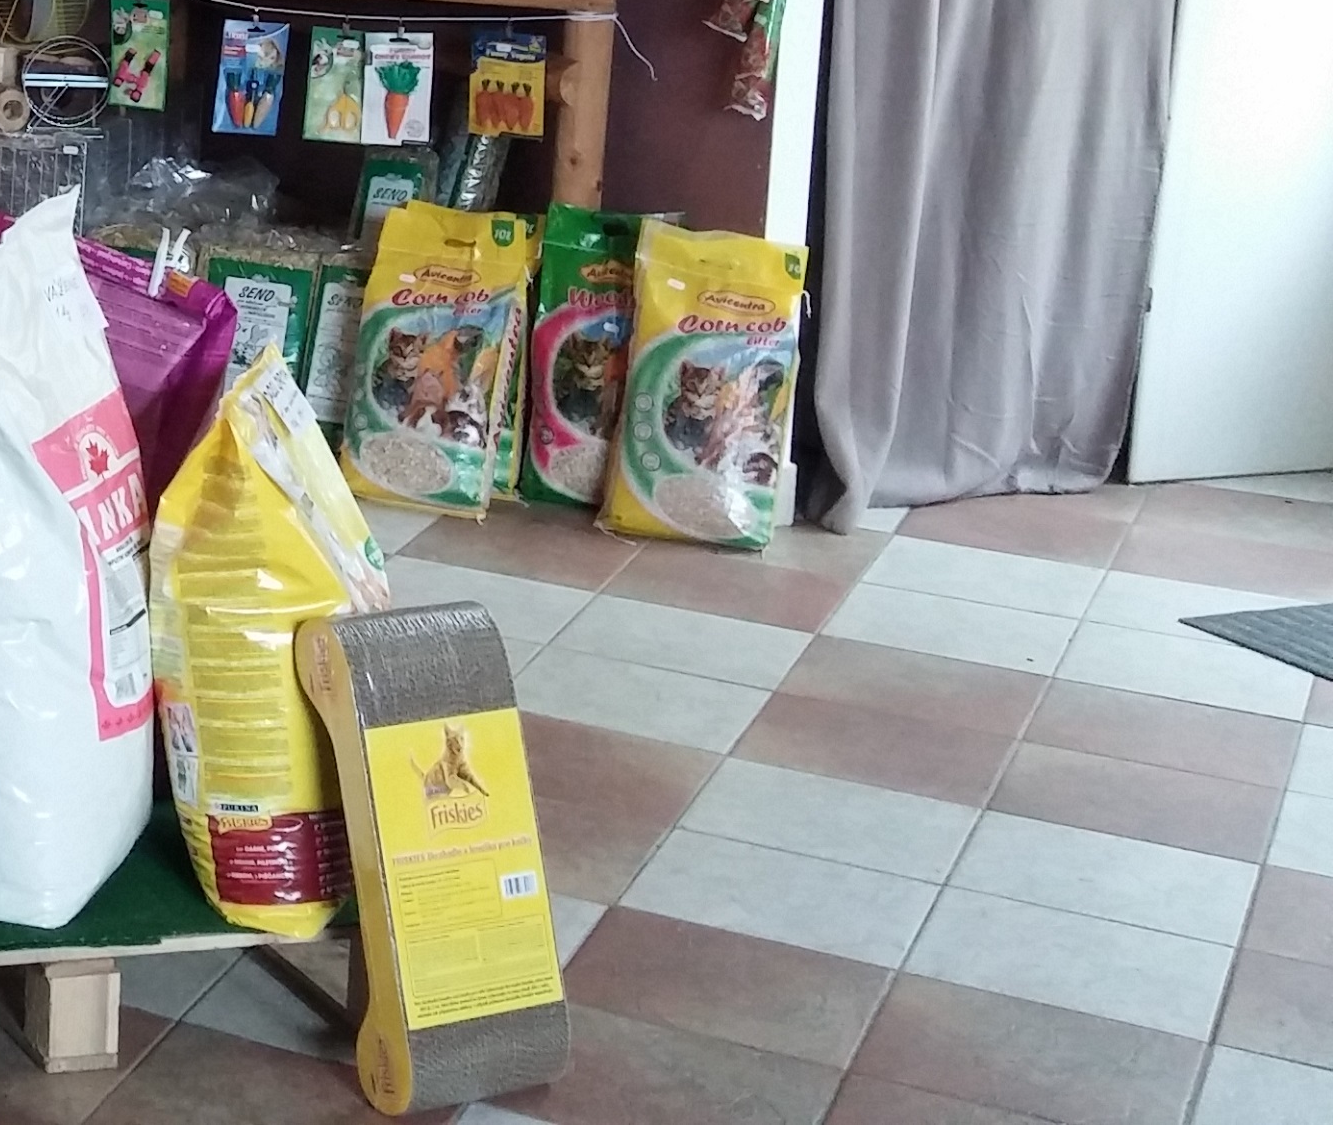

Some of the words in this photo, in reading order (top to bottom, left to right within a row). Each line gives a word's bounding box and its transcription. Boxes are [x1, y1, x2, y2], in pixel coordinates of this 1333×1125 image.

[371, 186, 408, 202] SENO
[238, 286, 276, 302] SENO
[392, 288, 449, 306] Corn
[706, 292, 767, 311] Avicentra
[678, 314, 740, 334] Corn
[745, 315, 787, 333] cob
[222, 804, 259, 813] PURINA
[430, 800, 484, 830] Friskies
